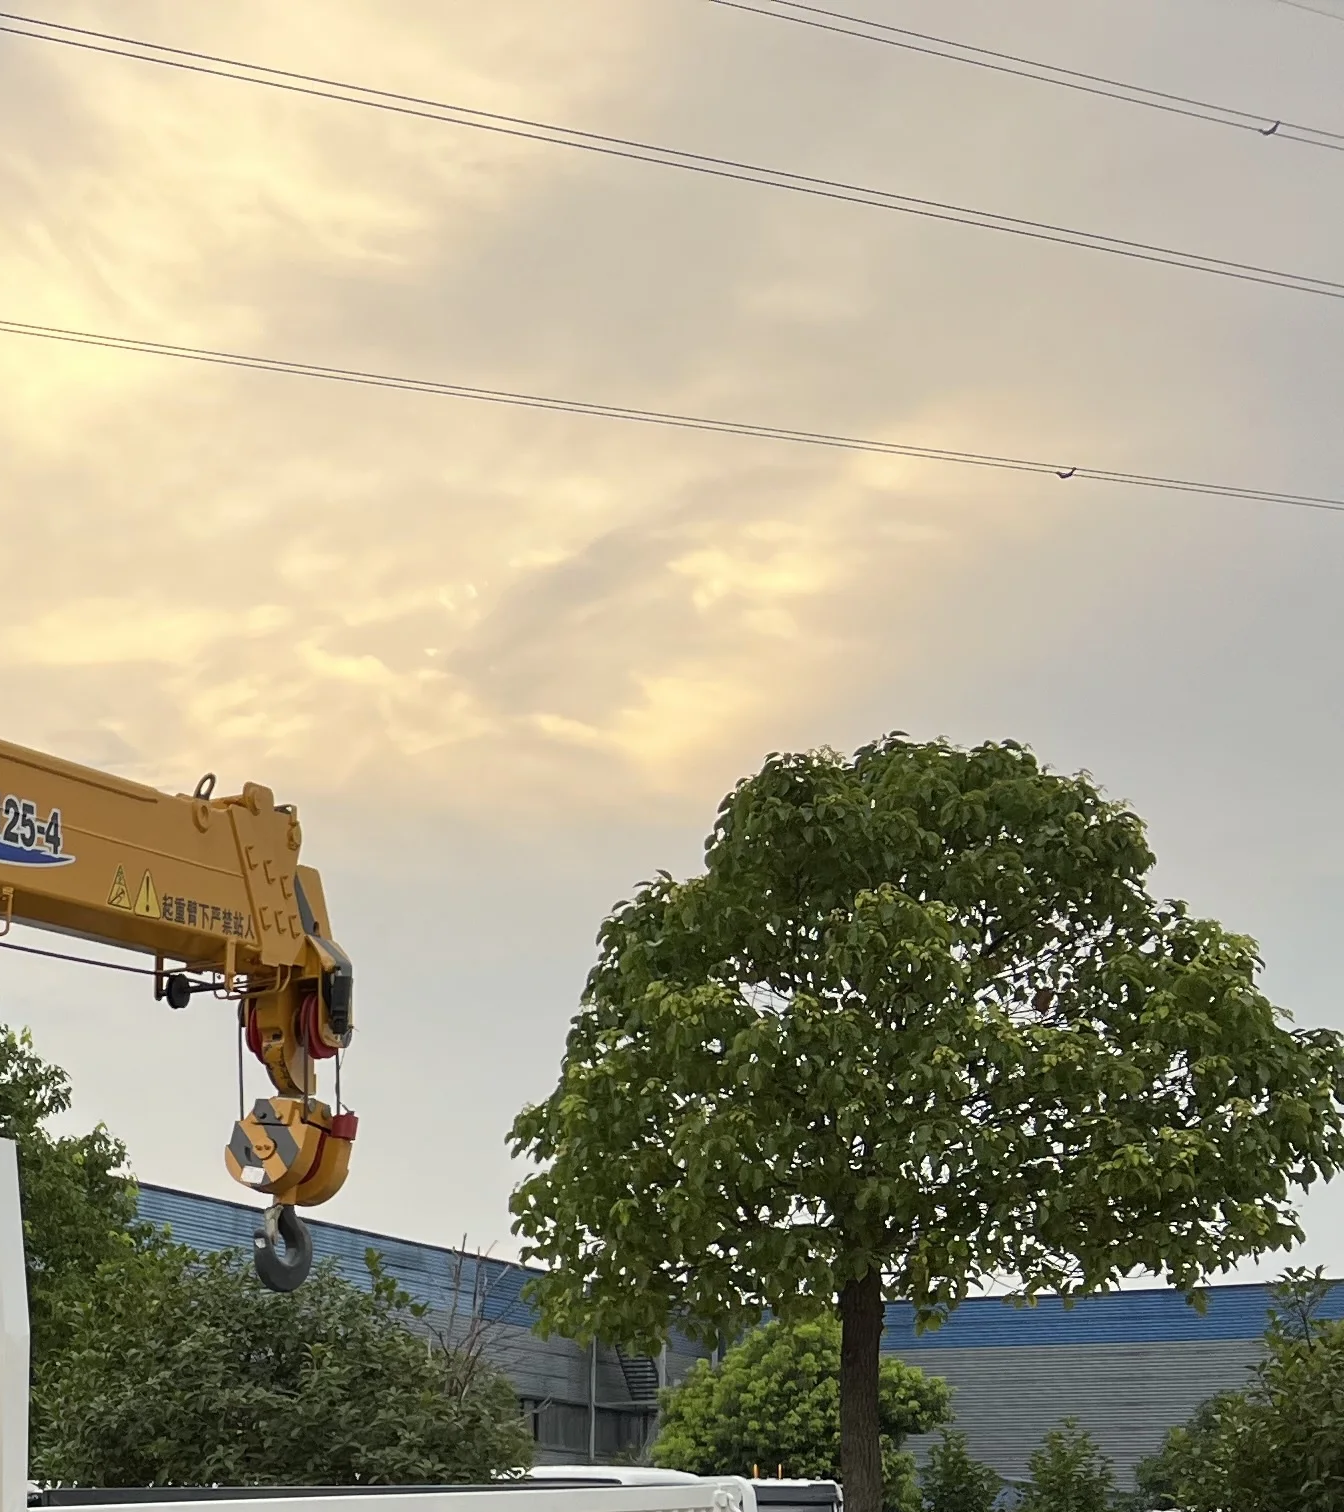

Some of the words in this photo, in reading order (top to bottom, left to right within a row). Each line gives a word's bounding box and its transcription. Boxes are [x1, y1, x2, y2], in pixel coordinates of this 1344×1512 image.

[161, 893, 255, 940] 起重臂下严禁站人
